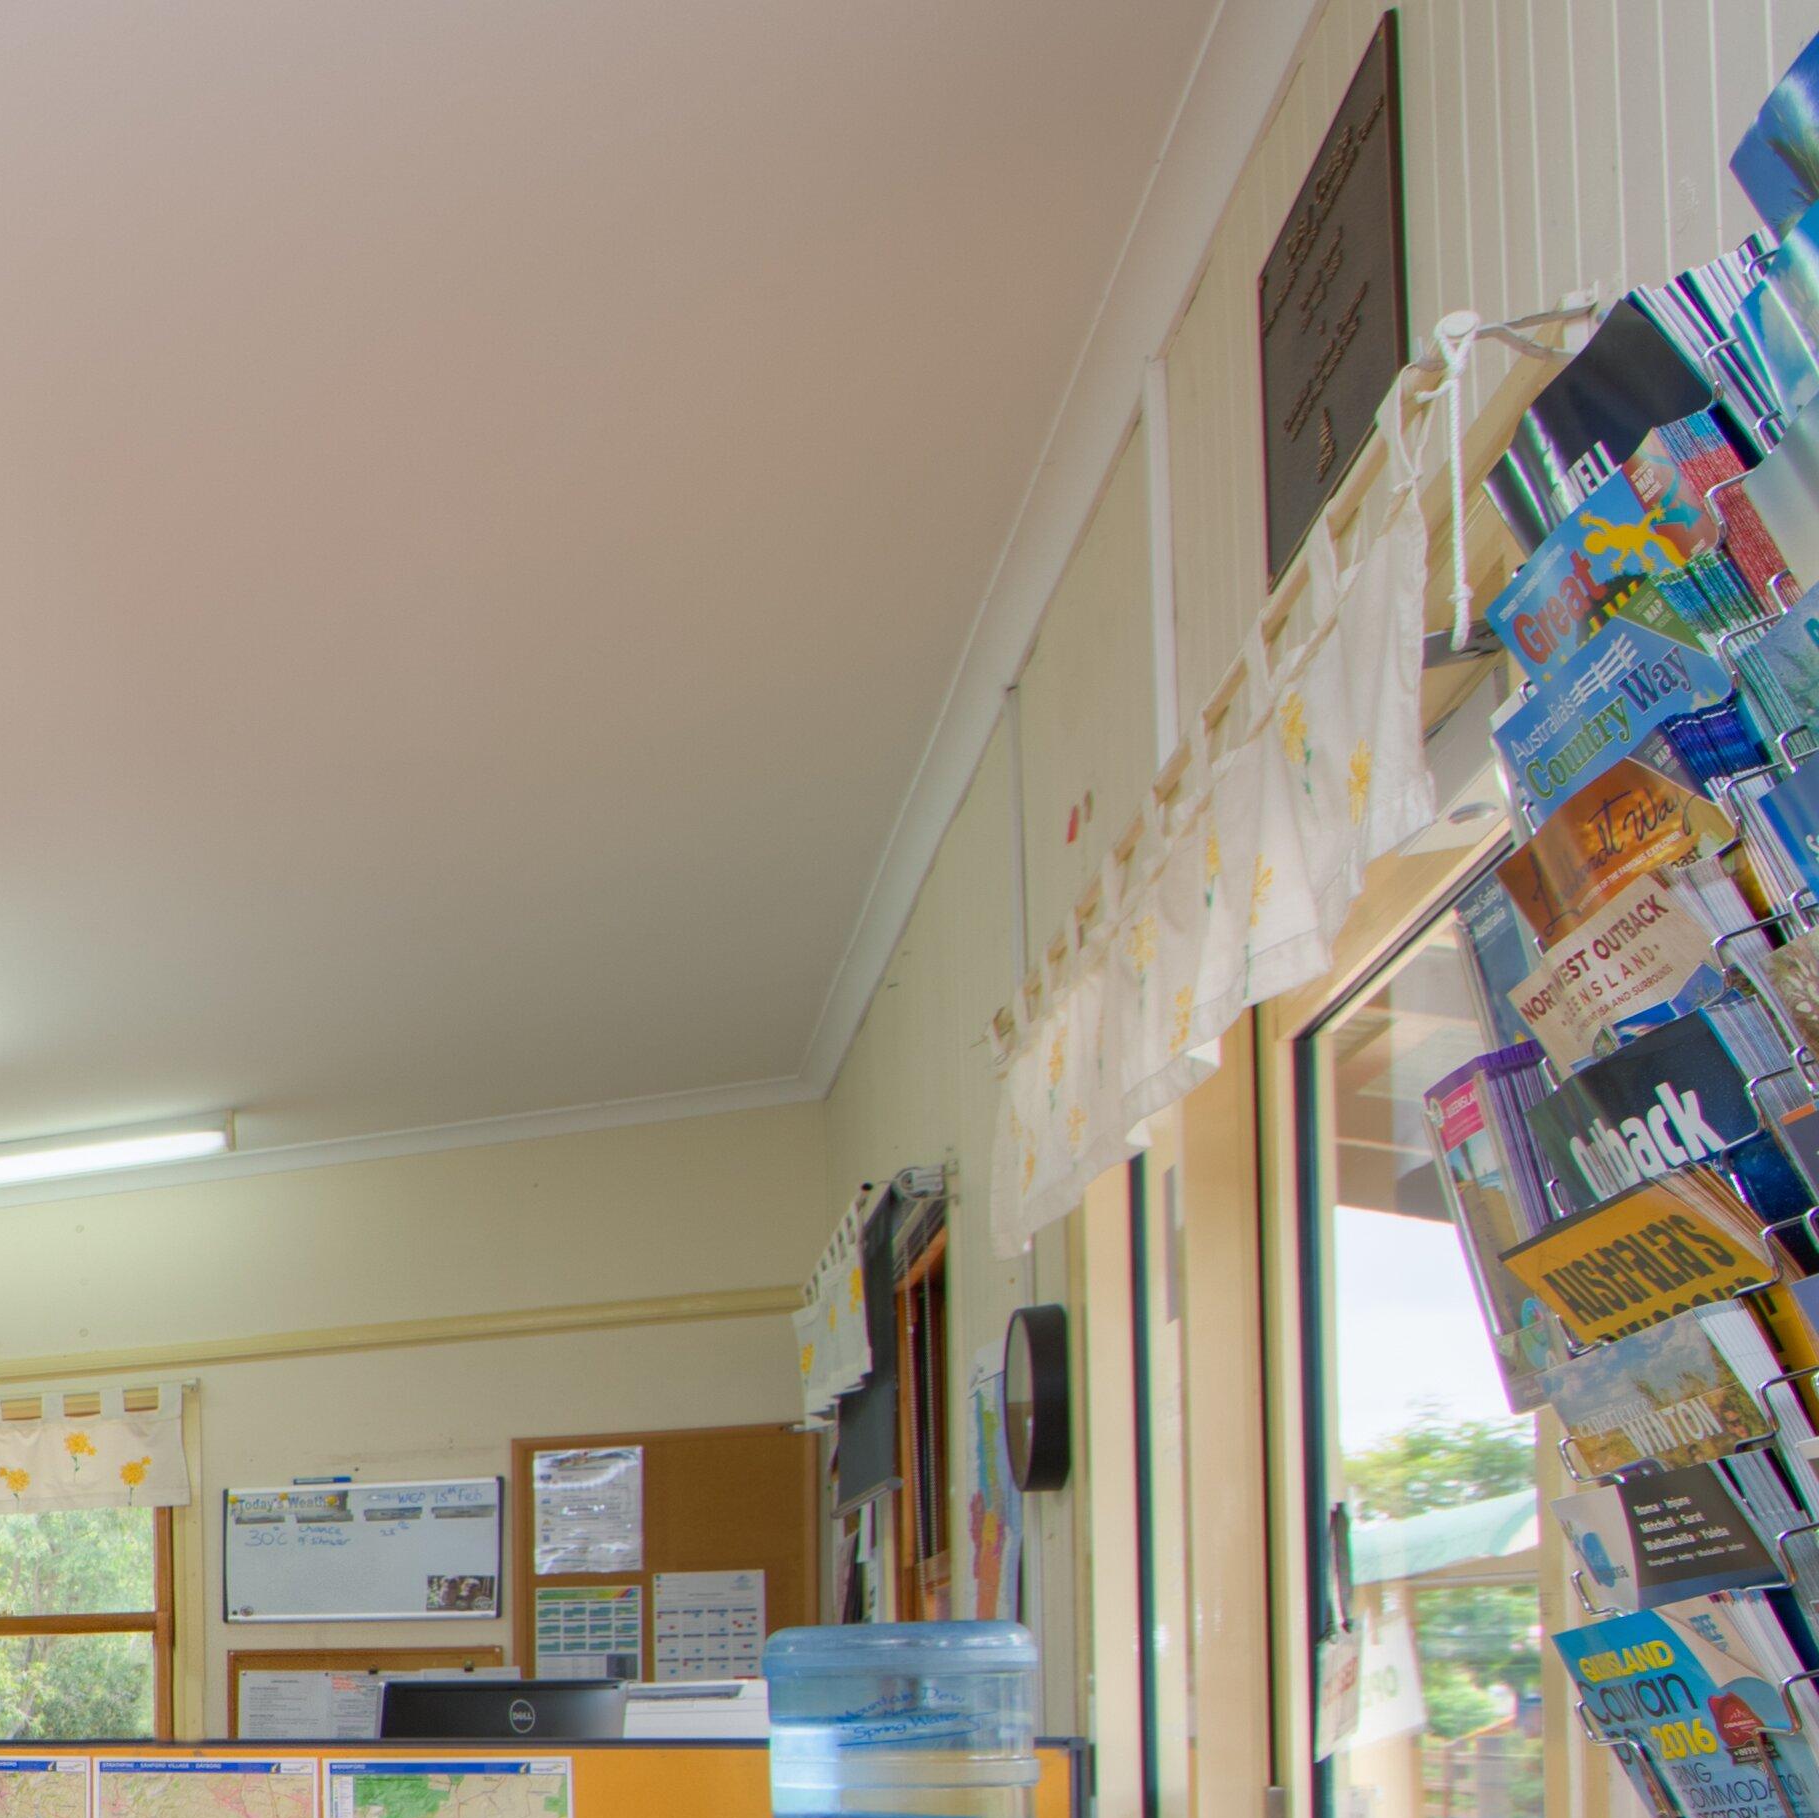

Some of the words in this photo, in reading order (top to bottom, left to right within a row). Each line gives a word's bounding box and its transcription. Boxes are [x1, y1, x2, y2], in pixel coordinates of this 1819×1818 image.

[1514, 551, 1607, 664] Great
[1511, 690, 1576, 757] Australia's
[1526, 697, 1632, 800] Country
[1618, 646, 1693, 714] Way
[1592, 894, 1669, 960] OUTBACK
[1620, 1395, 1723, 1457] WINTON
[1634, 1502, 1660, 1516] Roma
[1639, 1516, 1675, 1533] Mitchell
[1681, 1511, 1705, 1525] Surat
[513, 1711, 533, 1722] DELL
[1650, 1718, 1719, 1761] 2016
